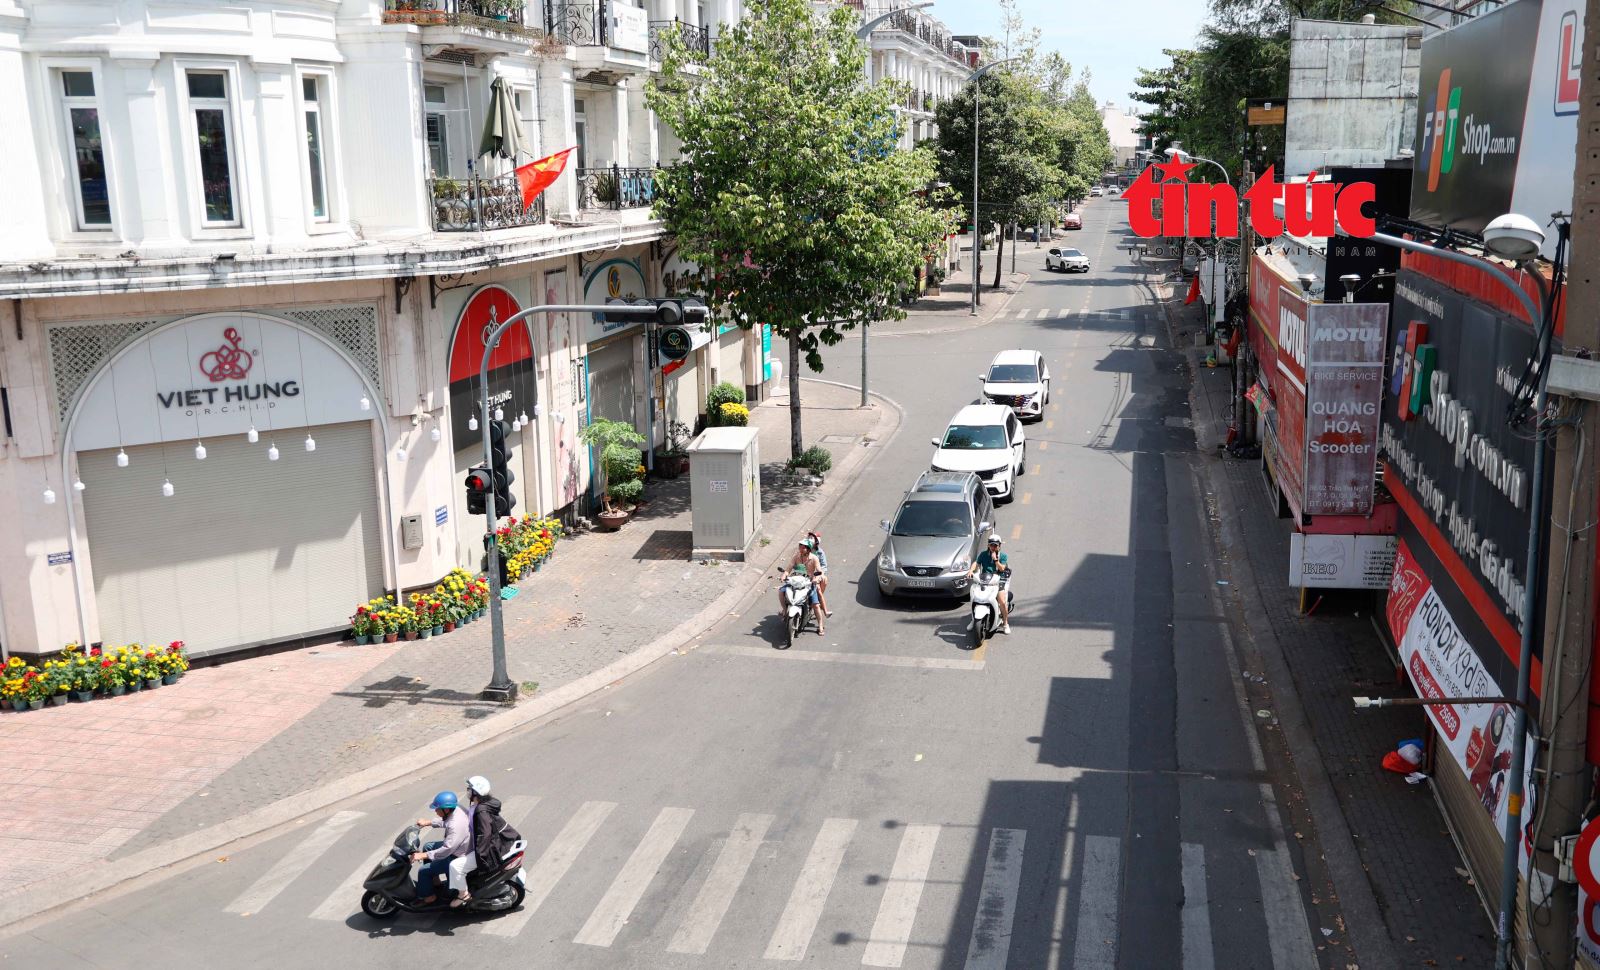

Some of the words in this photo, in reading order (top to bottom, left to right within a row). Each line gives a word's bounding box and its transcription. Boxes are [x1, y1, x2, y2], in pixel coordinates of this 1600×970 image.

[1422, 109, 1458, 153] FPT
[1279, 306, 1306, 369] MOTUL
[1314, 327, 1383, 342] MOTUL
[1314, 372, 1335, 381] BIKE
[1337, 372, 1377, 381] SERVICE
[157, 388, 218, 409] VIET
[224, 381, 300, 402] HUNG
[1312, 401, 1376, 415] QUANG
[1309, 441, 1371, 454] Scooter
[1417, 462, 1443, 523] Laptop
[1448, 501, 1475, 559] Apple
[1419, 591, 1458, 662] HONOR
[1450, 643, 1479, 690] X9d
